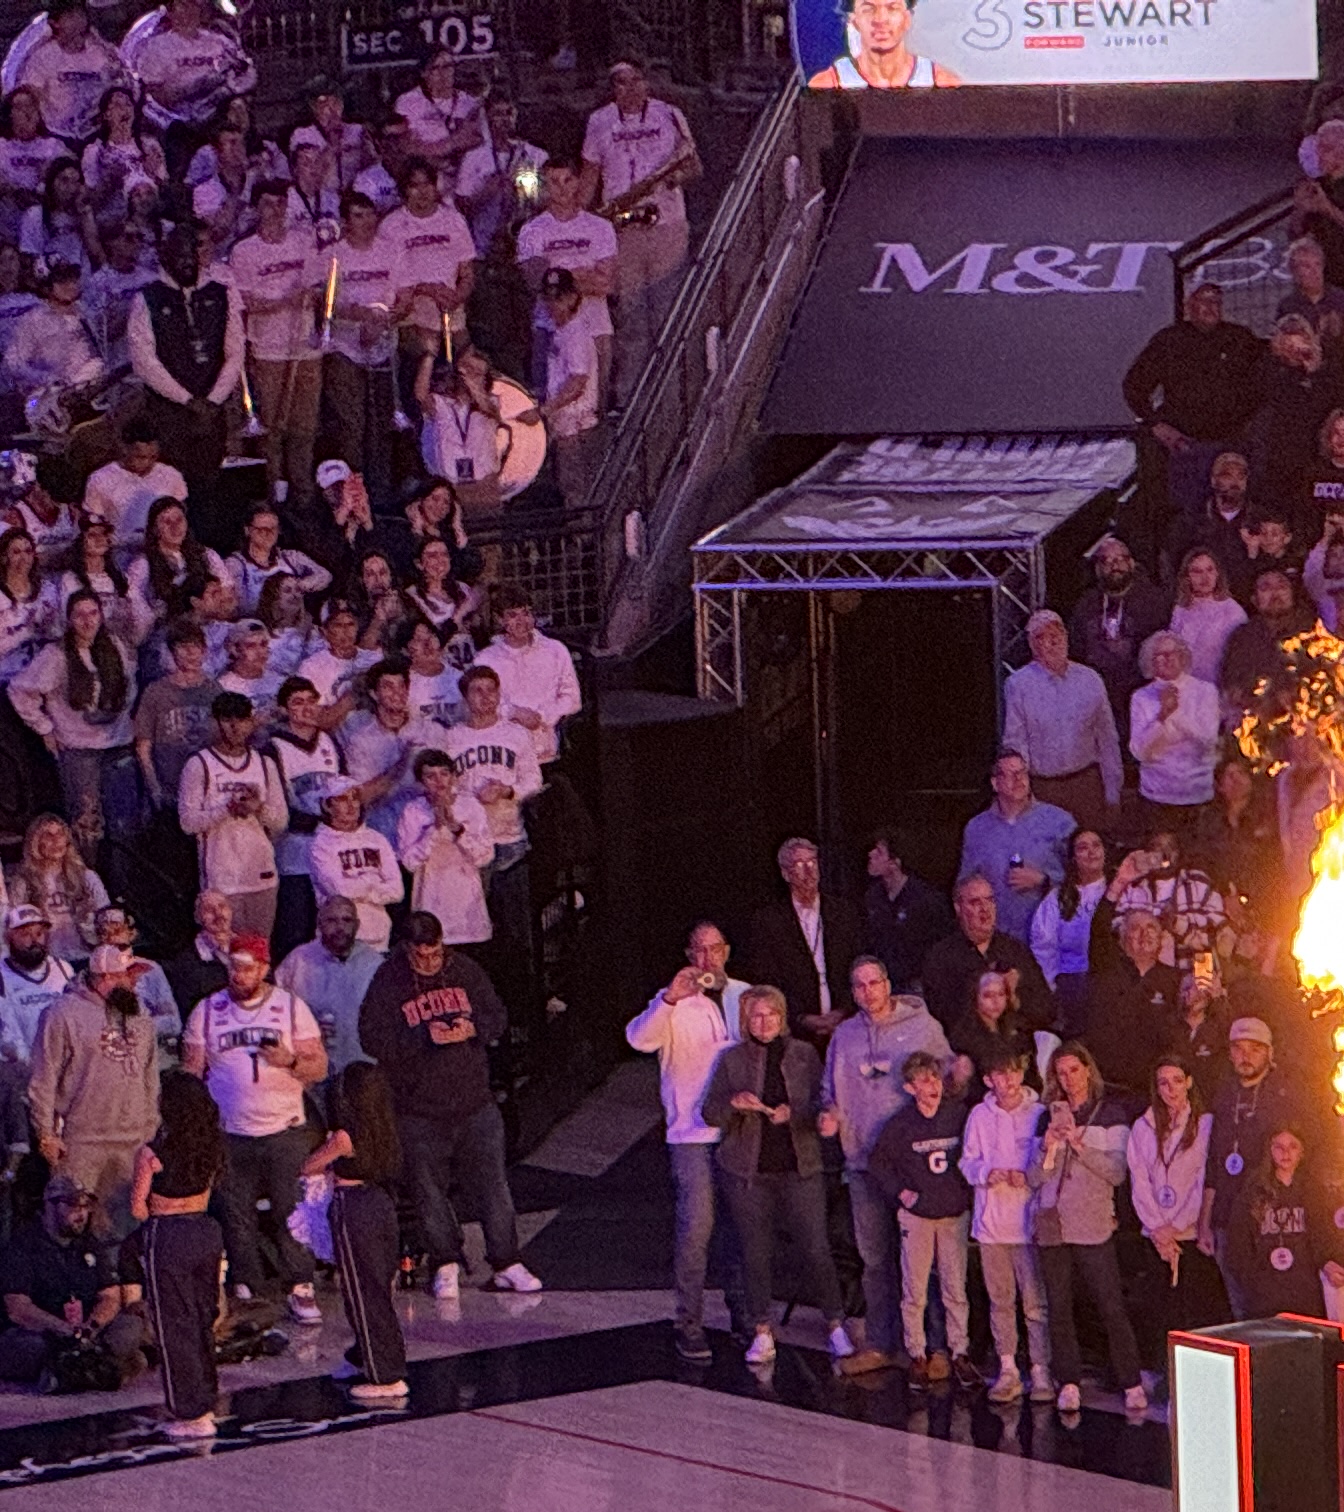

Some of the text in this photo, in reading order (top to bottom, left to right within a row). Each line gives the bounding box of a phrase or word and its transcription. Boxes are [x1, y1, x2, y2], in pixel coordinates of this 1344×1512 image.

[1024, 0, 1217, 28] STEWART
[352, 14, 495, 55] SEC 105
[1104, 34, 1169, 47] JUNIOR
[860, 241, 1182, 294] M&T
[452, 746, 517, 777] UCONN
[401, 987, 473, 1028] UCONN
[928, 1150, 949, 1174] G
